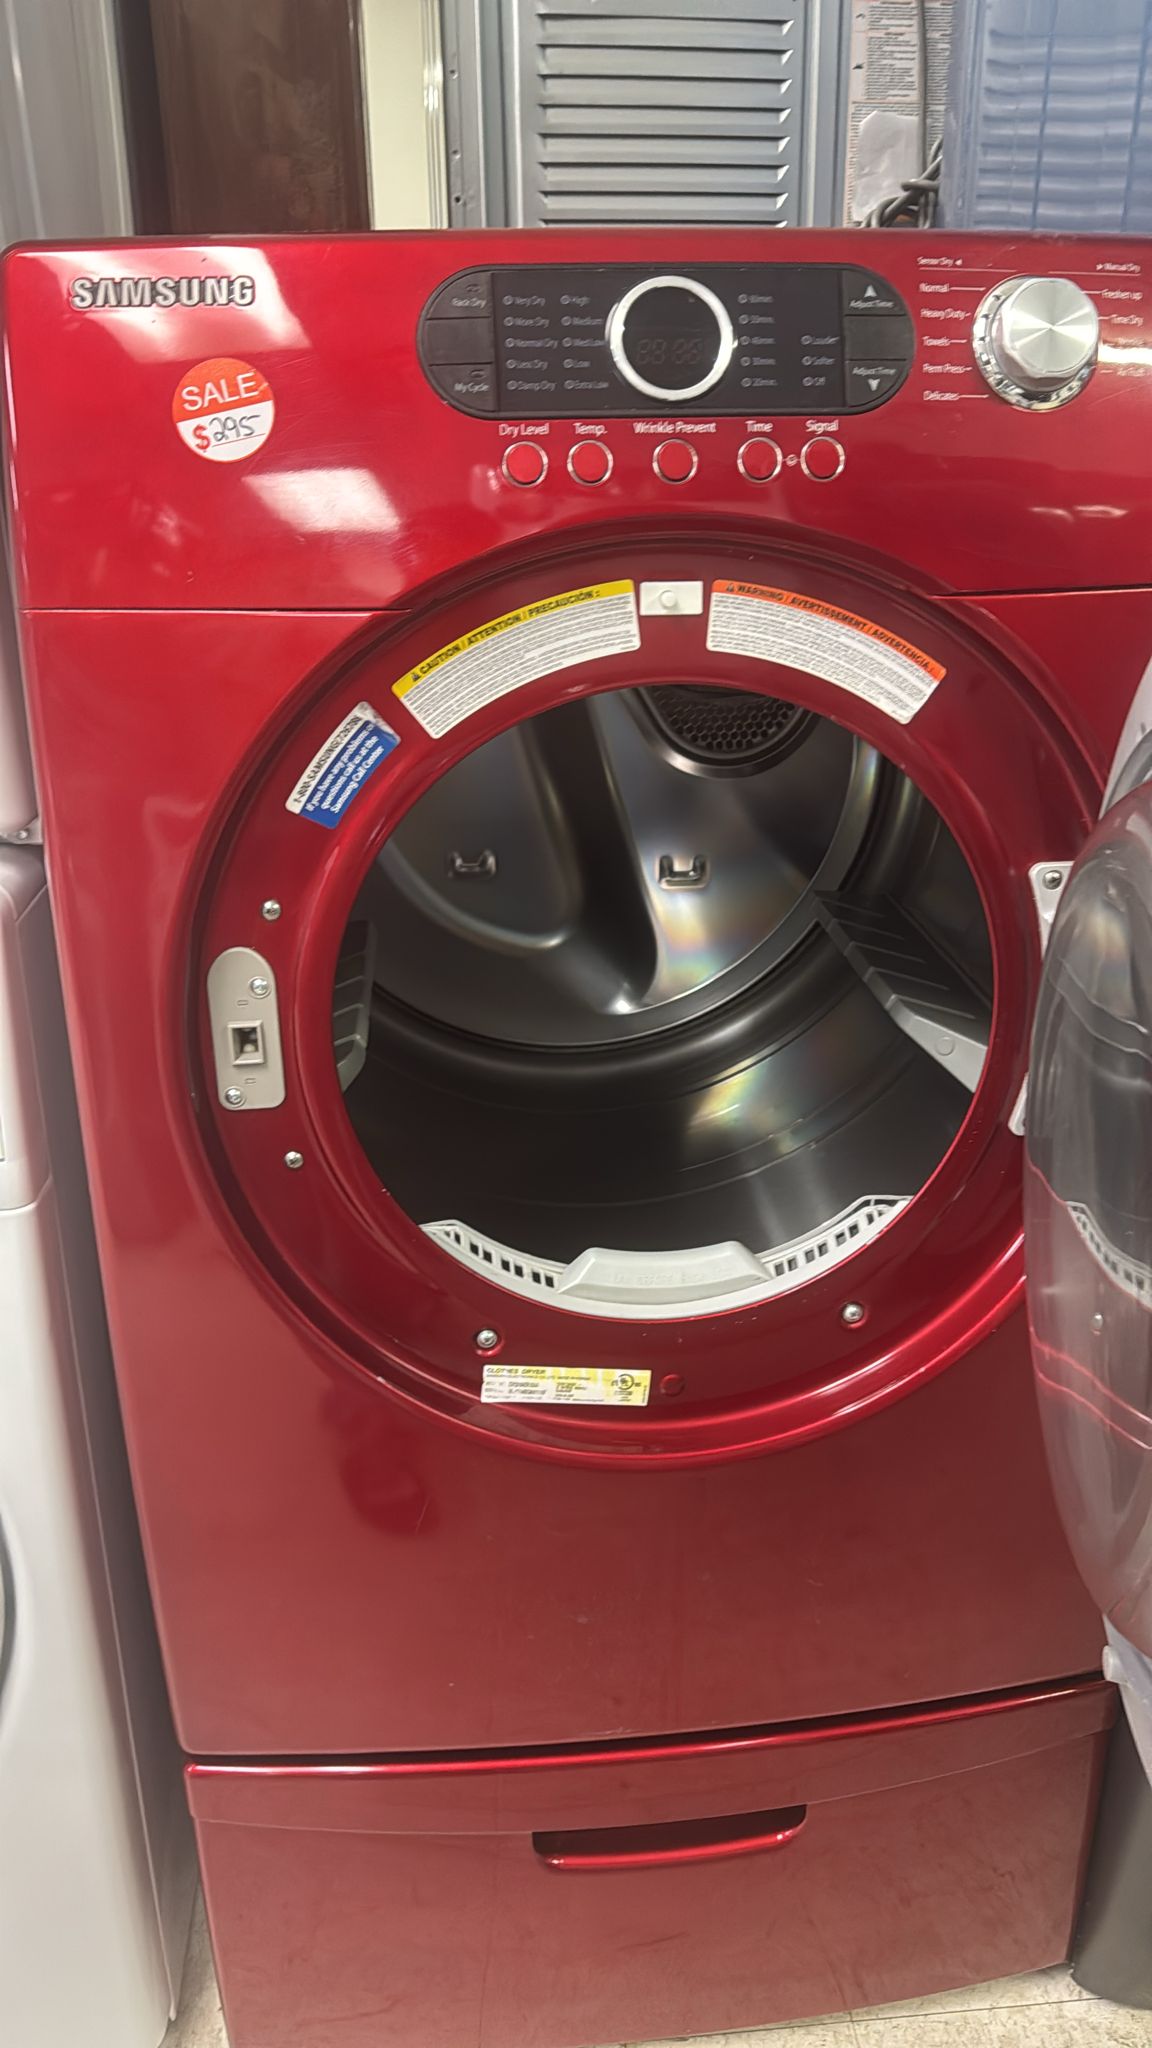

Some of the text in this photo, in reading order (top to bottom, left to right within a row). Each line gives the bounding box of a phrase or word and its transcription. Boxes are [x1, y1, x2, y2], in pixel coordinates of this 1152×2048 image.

[70, 276, 255, 308] SAMSUNG
[919, 283, 949, 293] Normal
[920, 308, 944, 320] Heavy
[922, 336, 951, 346] Towels
[180, 371, 259, 412] SALE
[454, 382, 489, 393] My Cycle
[192, 414, 261, 454] $295
[499, 422, 549, 438] Dry Level
[573, 422, 608, 437] Temp.
[633, 421, 716, 434] Wrinkle Prevent
[745, 420, 773, 432] Time
[805, 419, 839, 434] Signal
[737, 585, 783, 601] WARNING
[872, 629, 930, 669] ADVERTENCIA
[420, 645, 461, 675] CAUTION
[467, 614, 521, 646] ATTENTION
[317, 772, 335, 792] have
[339, 726, 370, 763] problems
[330, 780, 358, 814] Samsung
[361, 743, 384, 770] Center
[321, 775, 347, 810] questions
